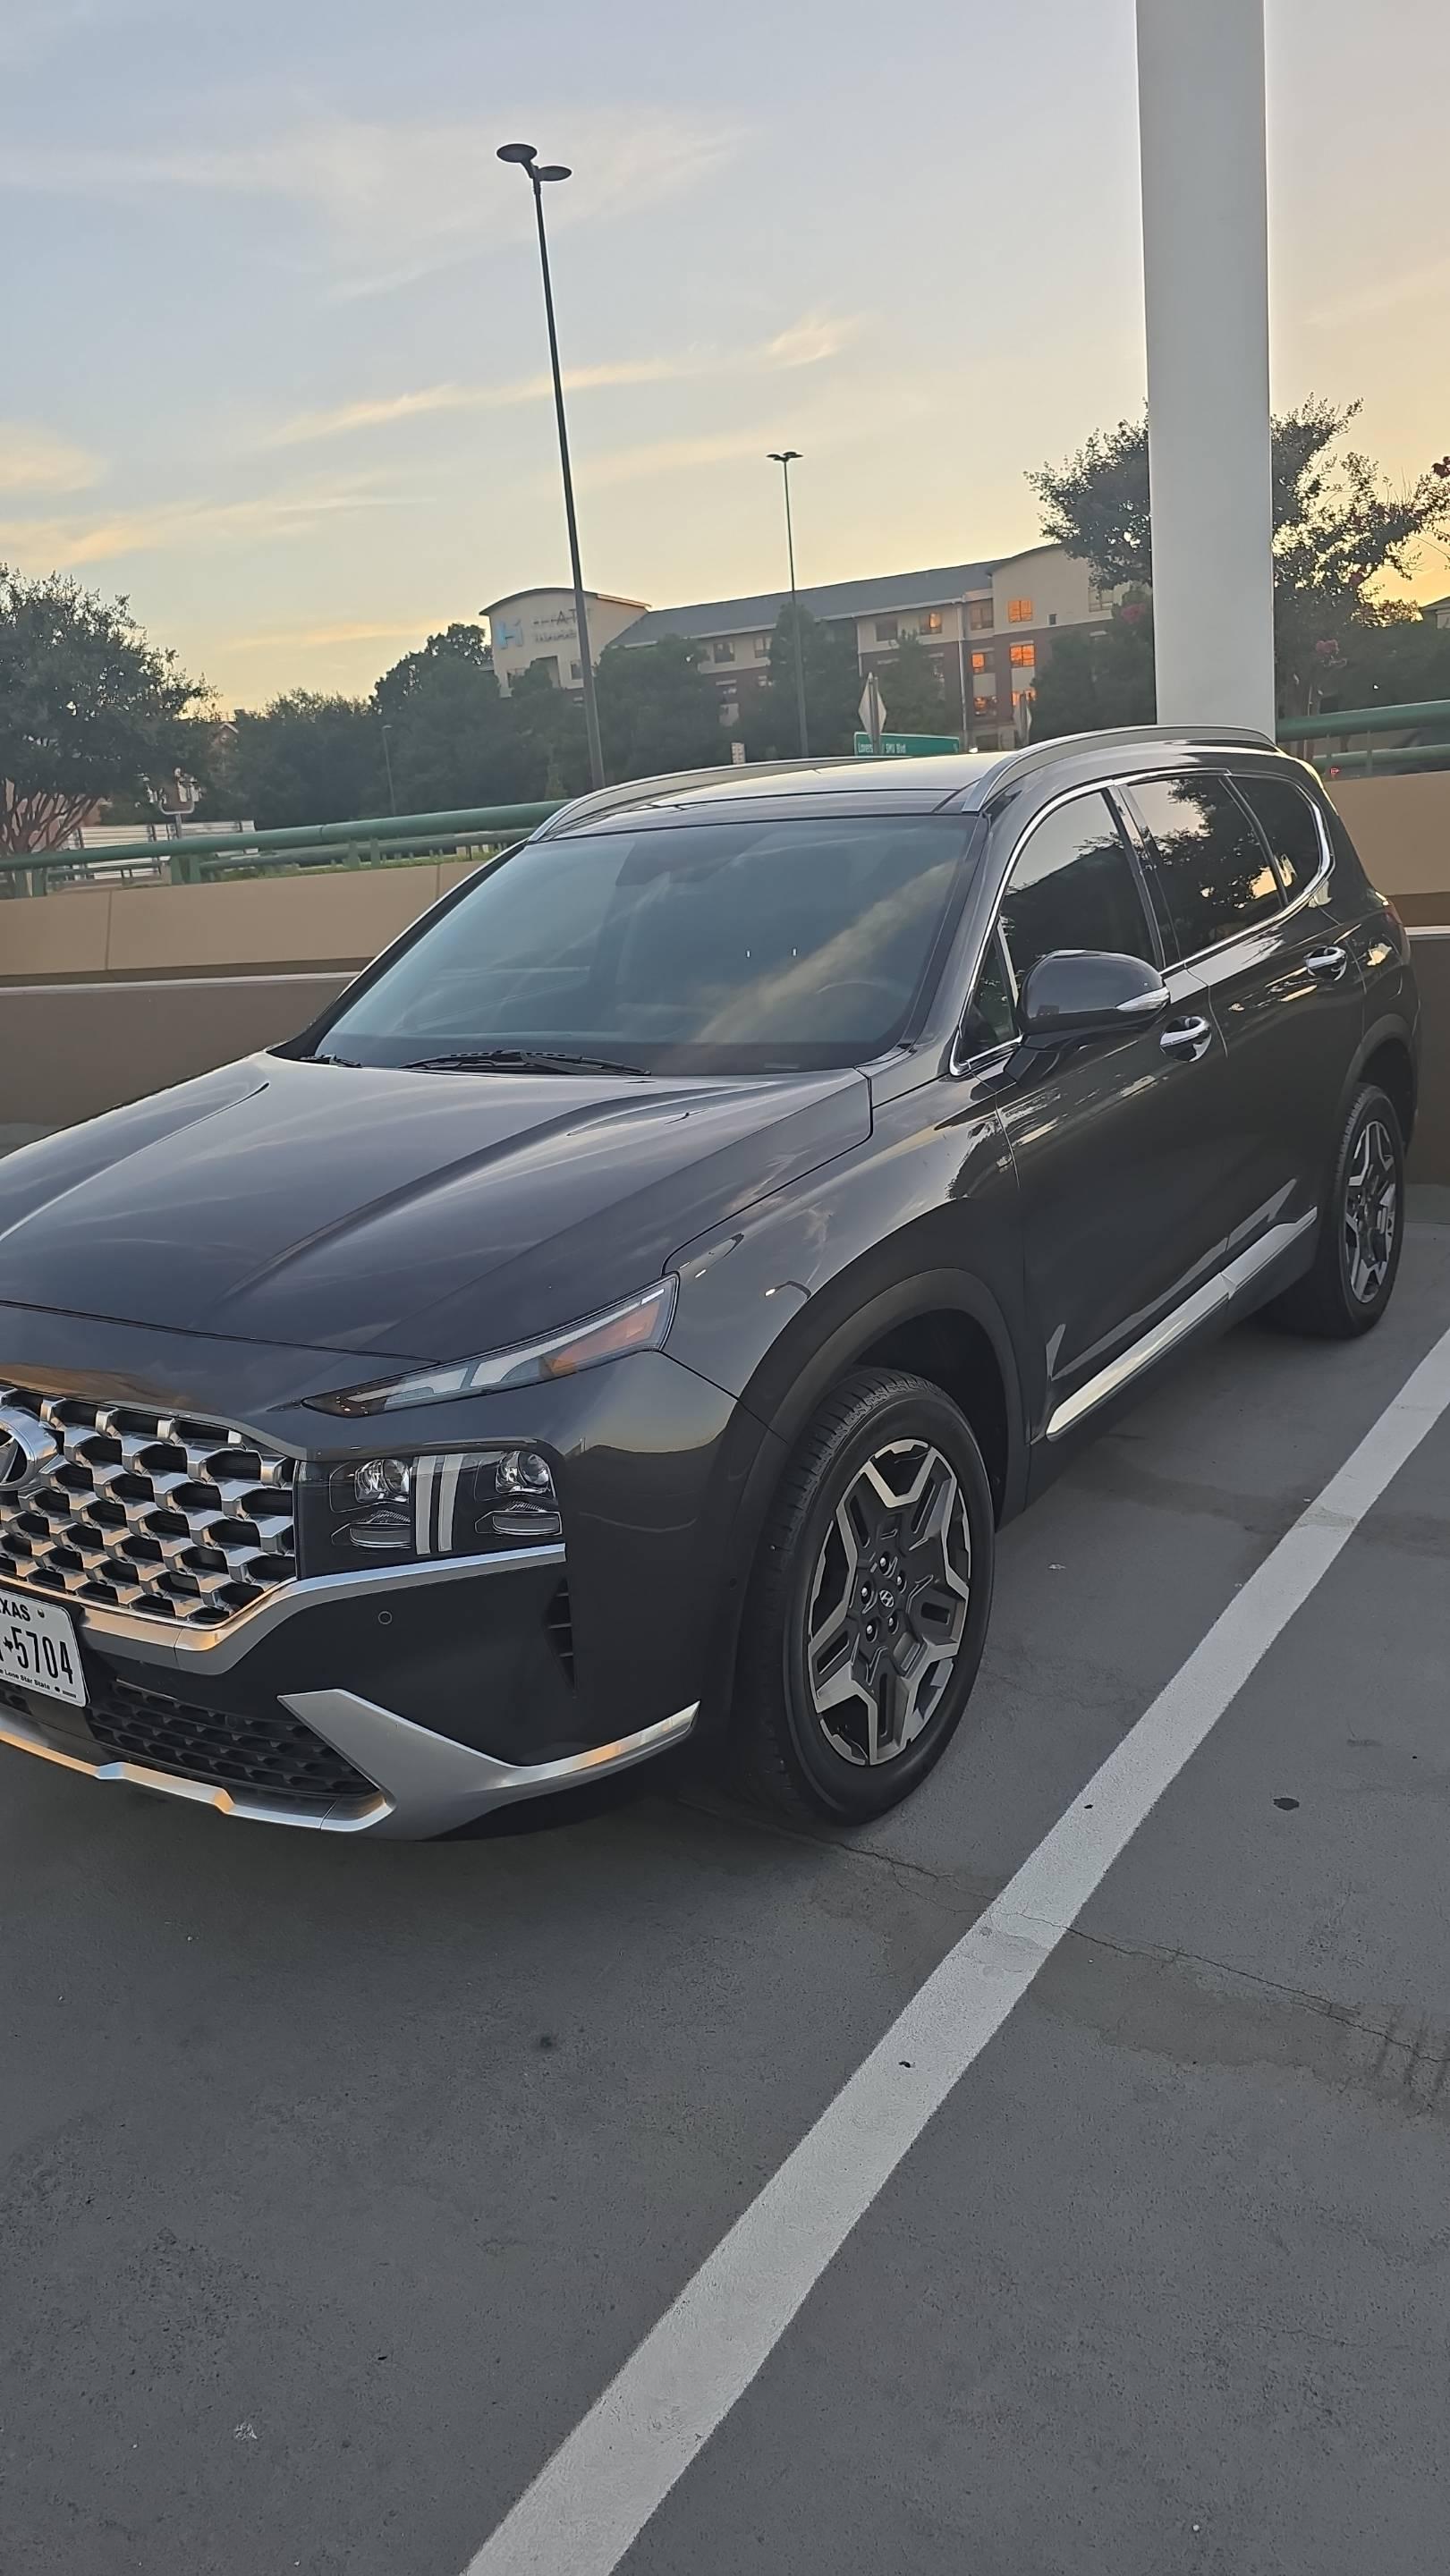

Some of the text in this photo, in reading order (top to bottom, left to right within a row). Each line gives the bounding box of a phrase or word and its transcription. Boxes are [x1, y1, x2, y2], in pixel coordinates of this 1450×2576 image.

[0, 1597, 30, 1622] XAS
[4, 1669, 19, 1680] Lone
[20, 1674, 33, 1684] Star
[34, 1679, 50, 1690] State
